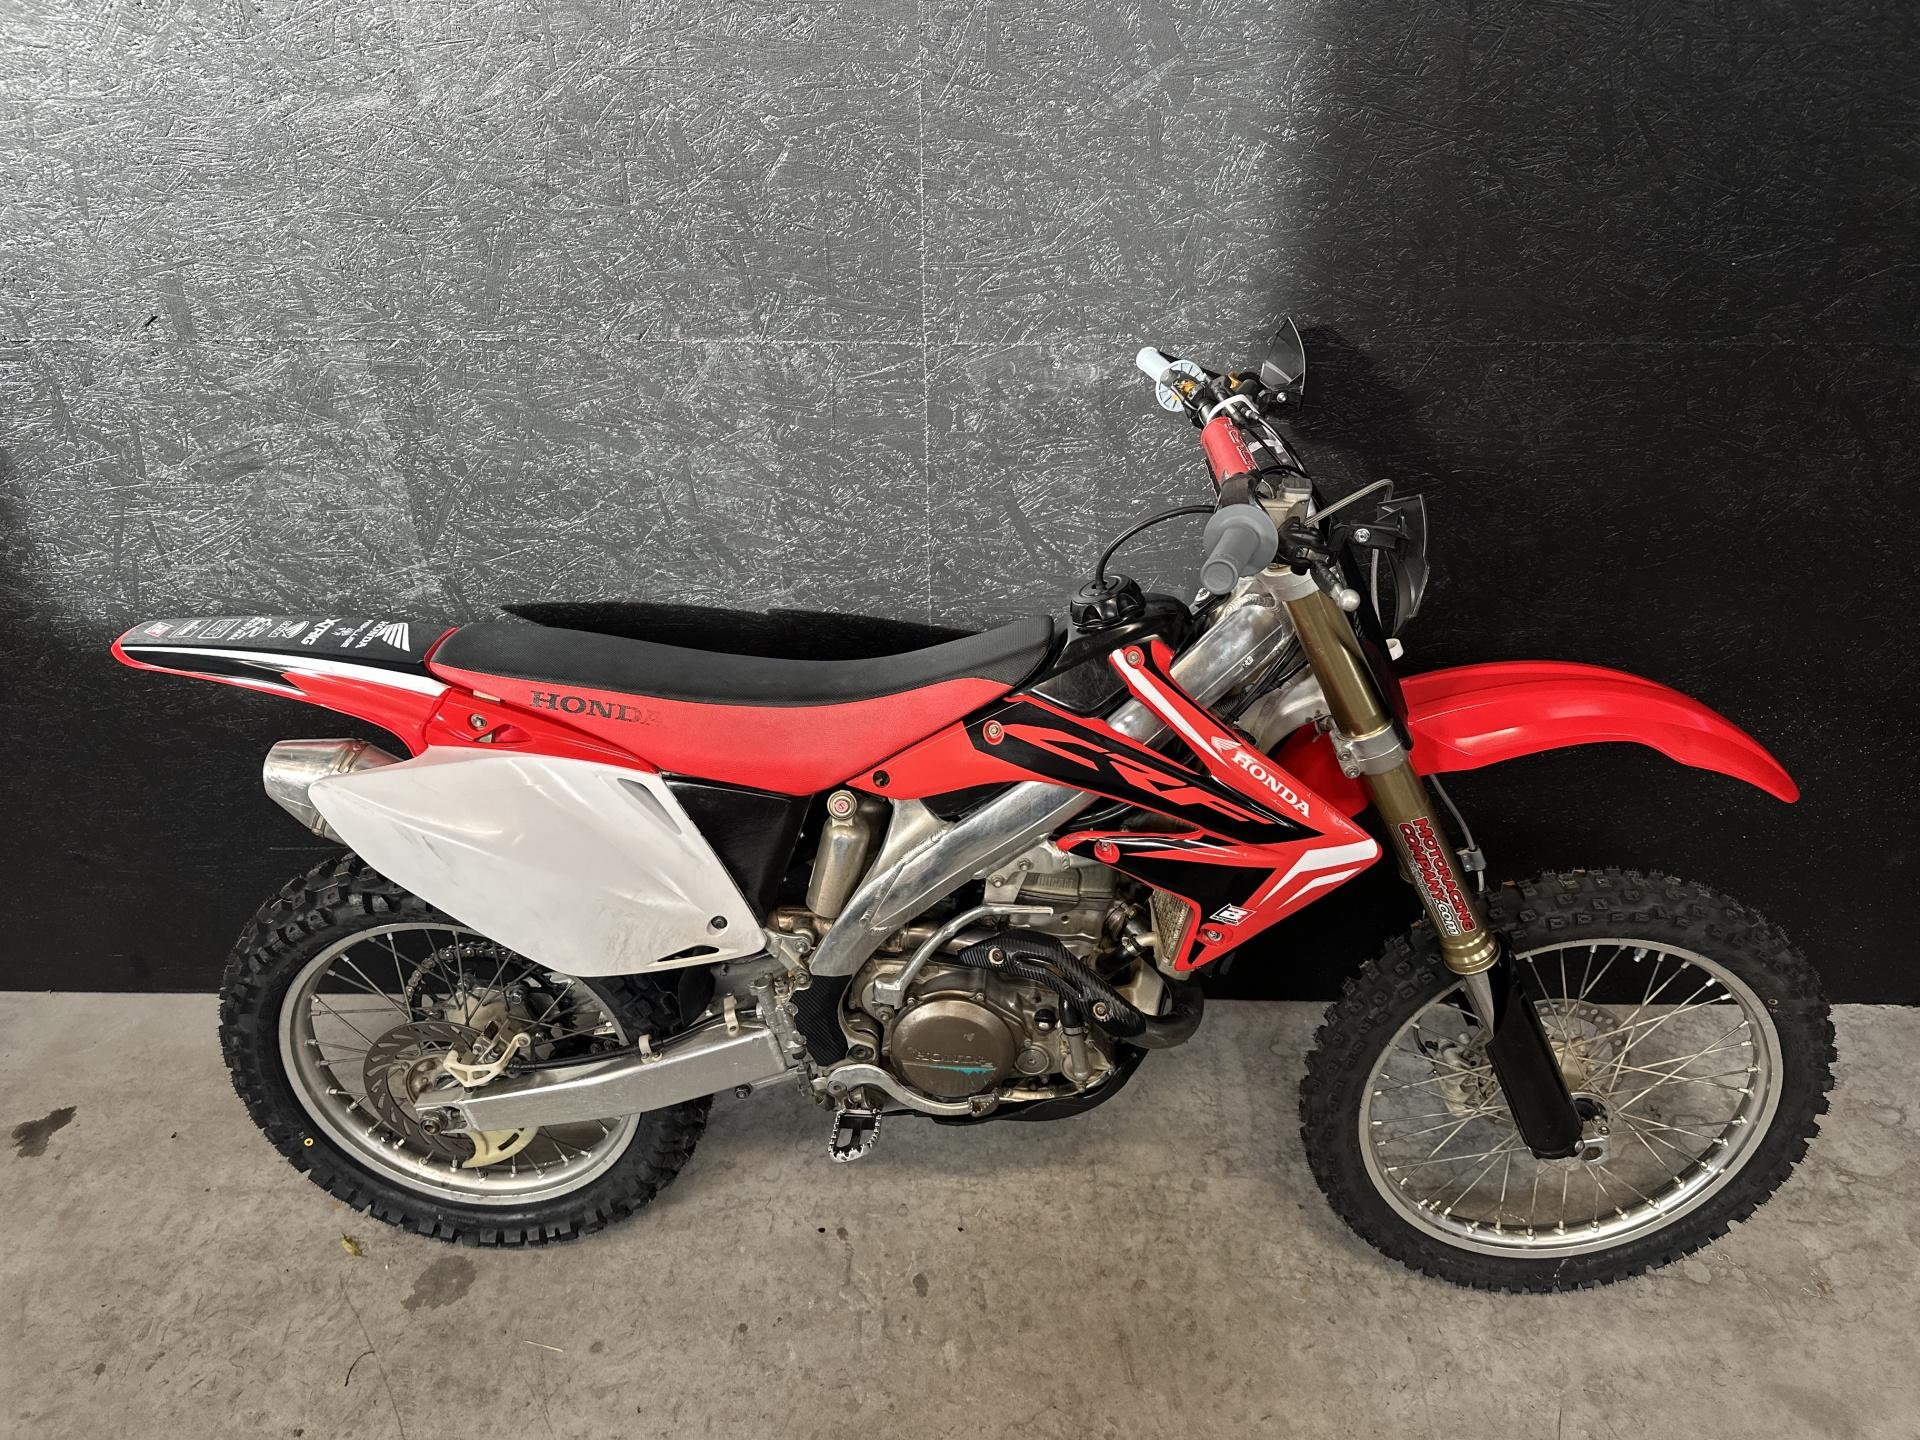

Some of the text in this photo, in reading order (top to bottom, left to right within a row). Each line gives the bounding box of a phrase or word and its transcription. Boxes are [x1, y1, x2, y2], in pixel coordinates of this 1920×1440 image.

[300, 618, 342, 645] XTRIG
[354, 620, 390, 648] HONDA
[530, 690, 657, 726] HOND
[1003, 724, 1276, 824] CRF
[1231, 751, 1311, 818] HONDA
[1411, 816, 1476, 932] MOTORACING
